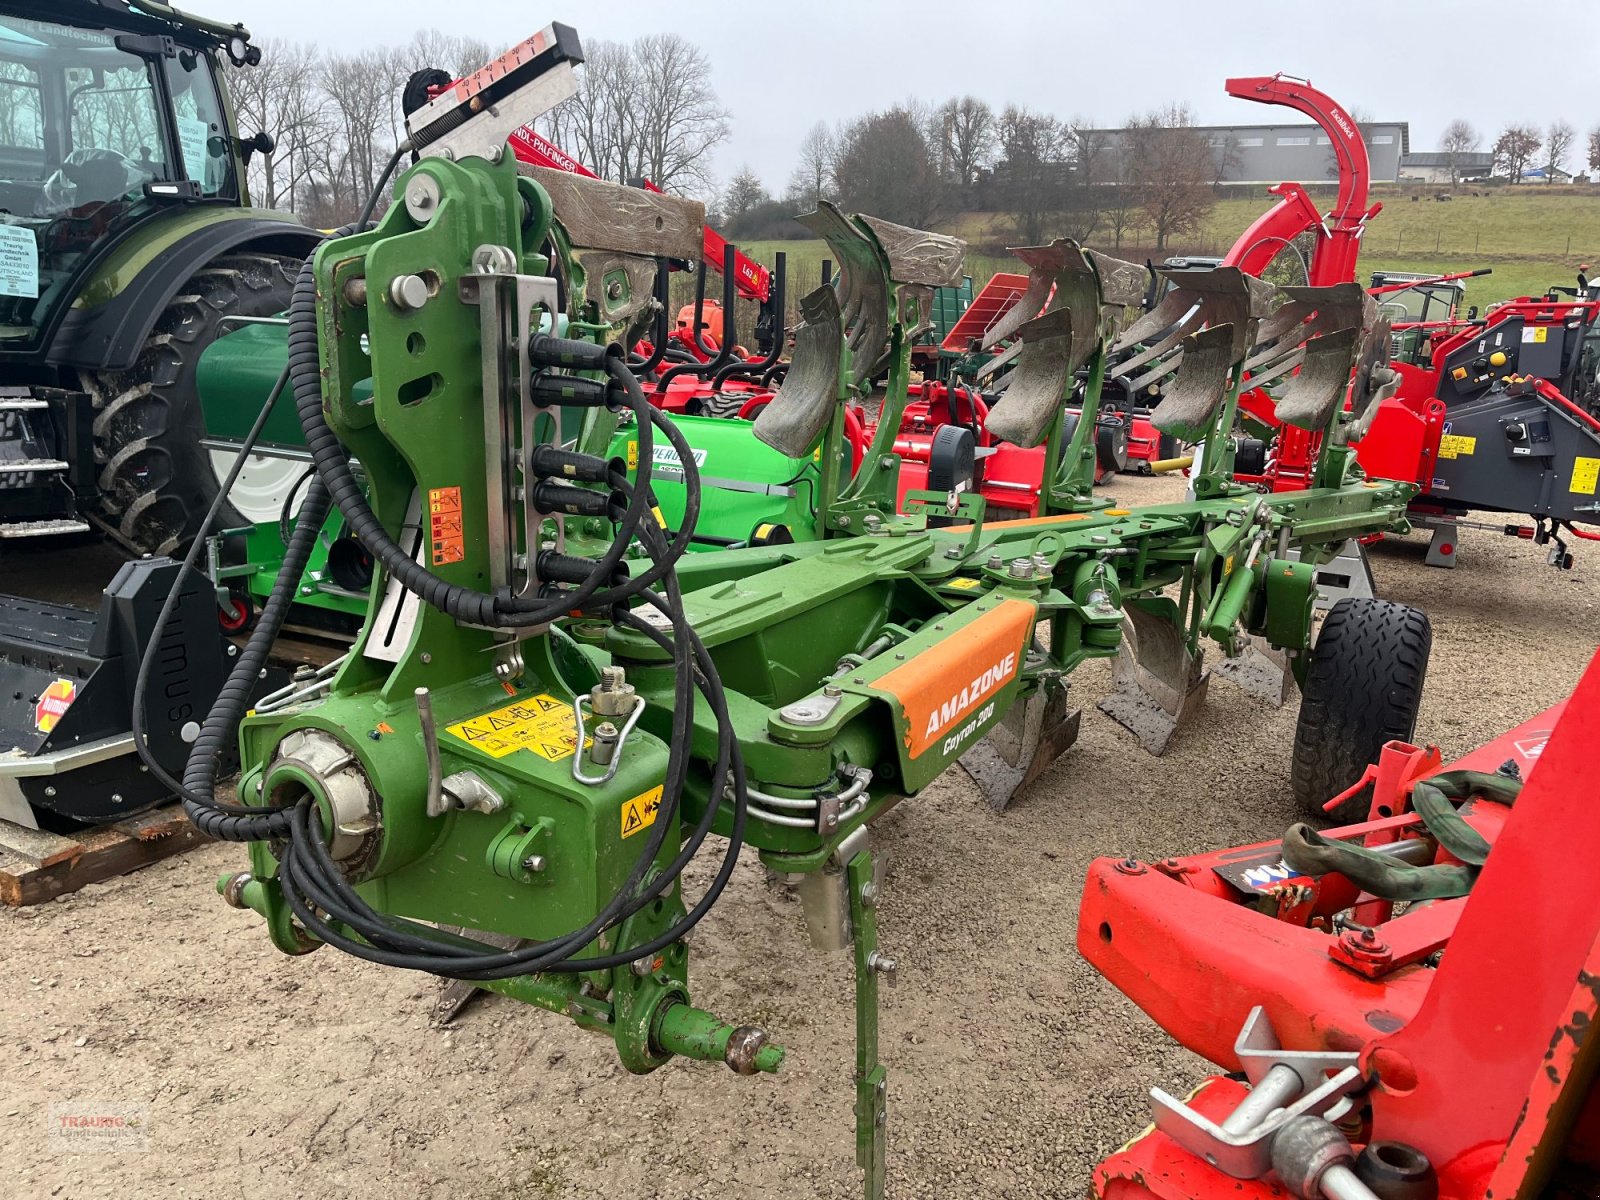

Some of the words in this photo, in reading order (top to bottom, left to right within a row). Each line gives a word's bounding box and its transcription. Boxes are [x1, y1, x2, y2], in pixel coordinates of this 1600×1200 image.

[38, 22, 113, 46] Landtechnik
[742, 263, 753, 279] L62
[925, 651, 1015, 740] AMAZONE
[976, 702, 995, 728] 200
